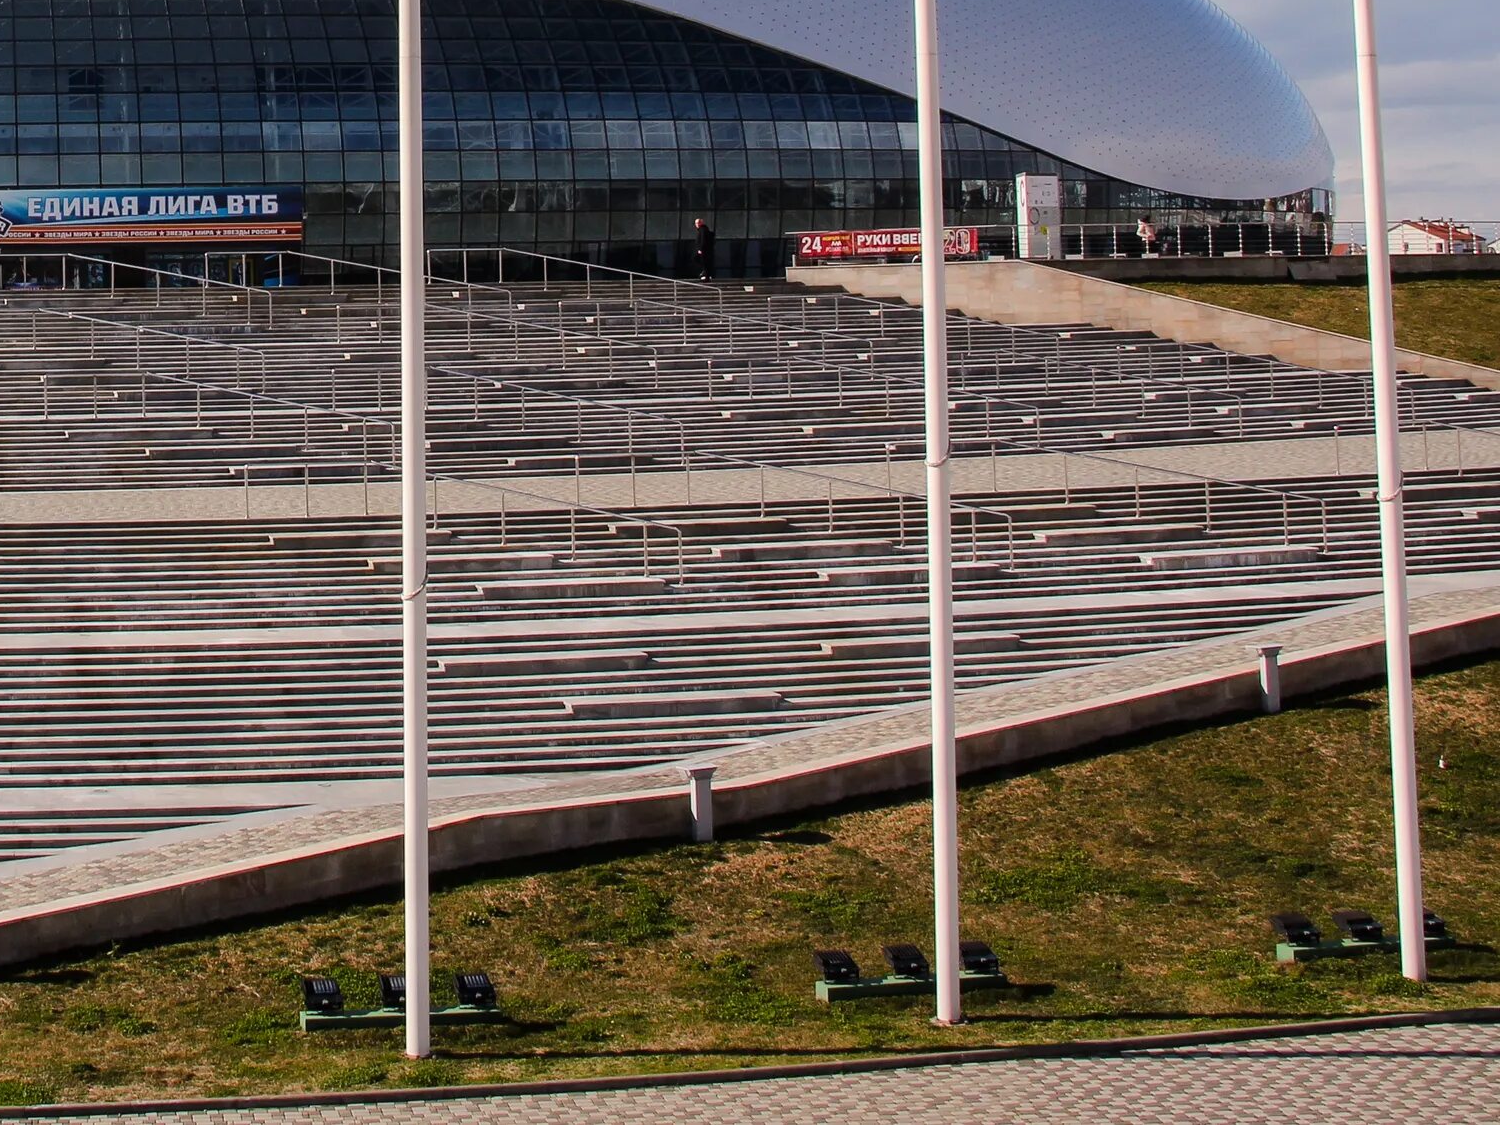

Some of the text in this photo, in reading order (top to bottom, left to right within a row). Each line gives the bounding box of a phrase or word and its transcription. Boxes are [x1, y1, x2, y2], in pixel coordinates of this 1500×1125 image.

[27, 194, 279, 221] ЕДИНАЯ ЛИГА ВТБ
[802, 236, 822, 253] 24
[857, 234, 891, 245] РУКИ
[893, 233, 922, 245] ВВЕ
